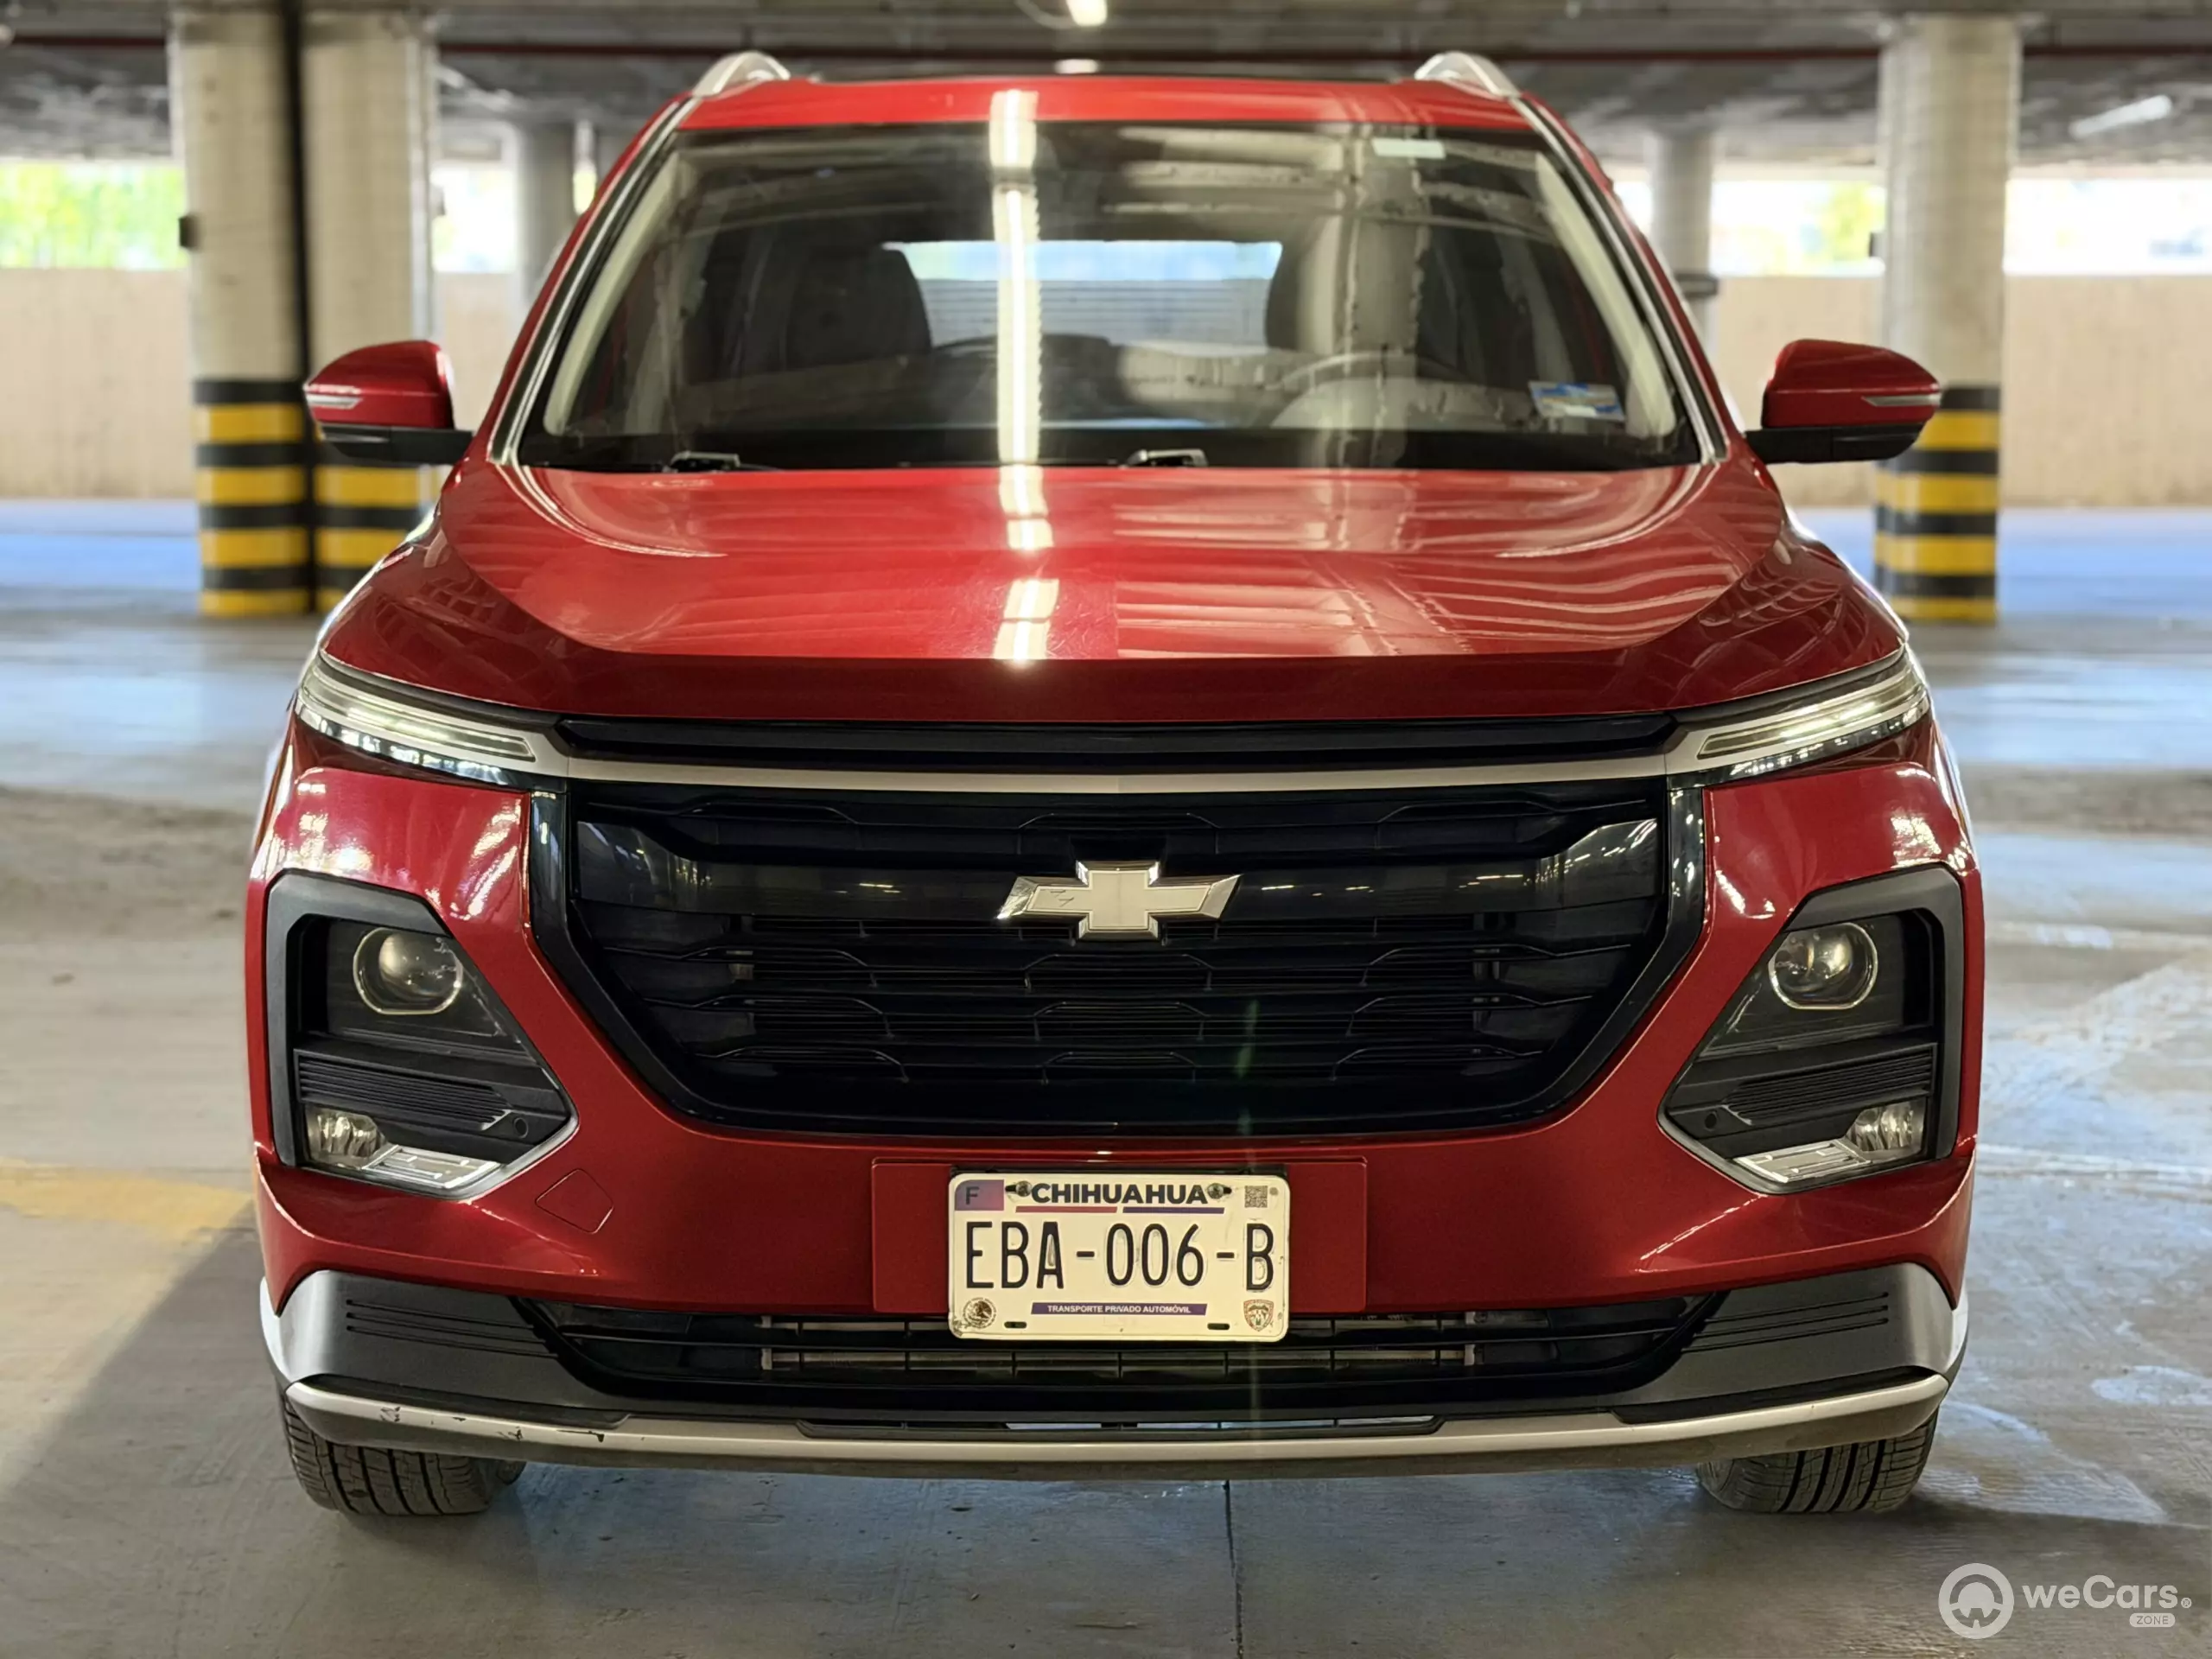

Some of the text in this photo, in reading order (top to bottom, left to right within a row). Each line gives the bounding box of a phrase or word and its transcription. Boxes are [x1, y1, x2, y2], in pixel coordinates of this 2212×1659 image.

[965, 1185, 980, 1205] F
[1031, 1182, 1209, 1205] CHIHUAHUA
[965, 1220, 1274, 1292] EBA-006-B
[1142, 1304, 1192, 1314] AUTOMÓVIL
